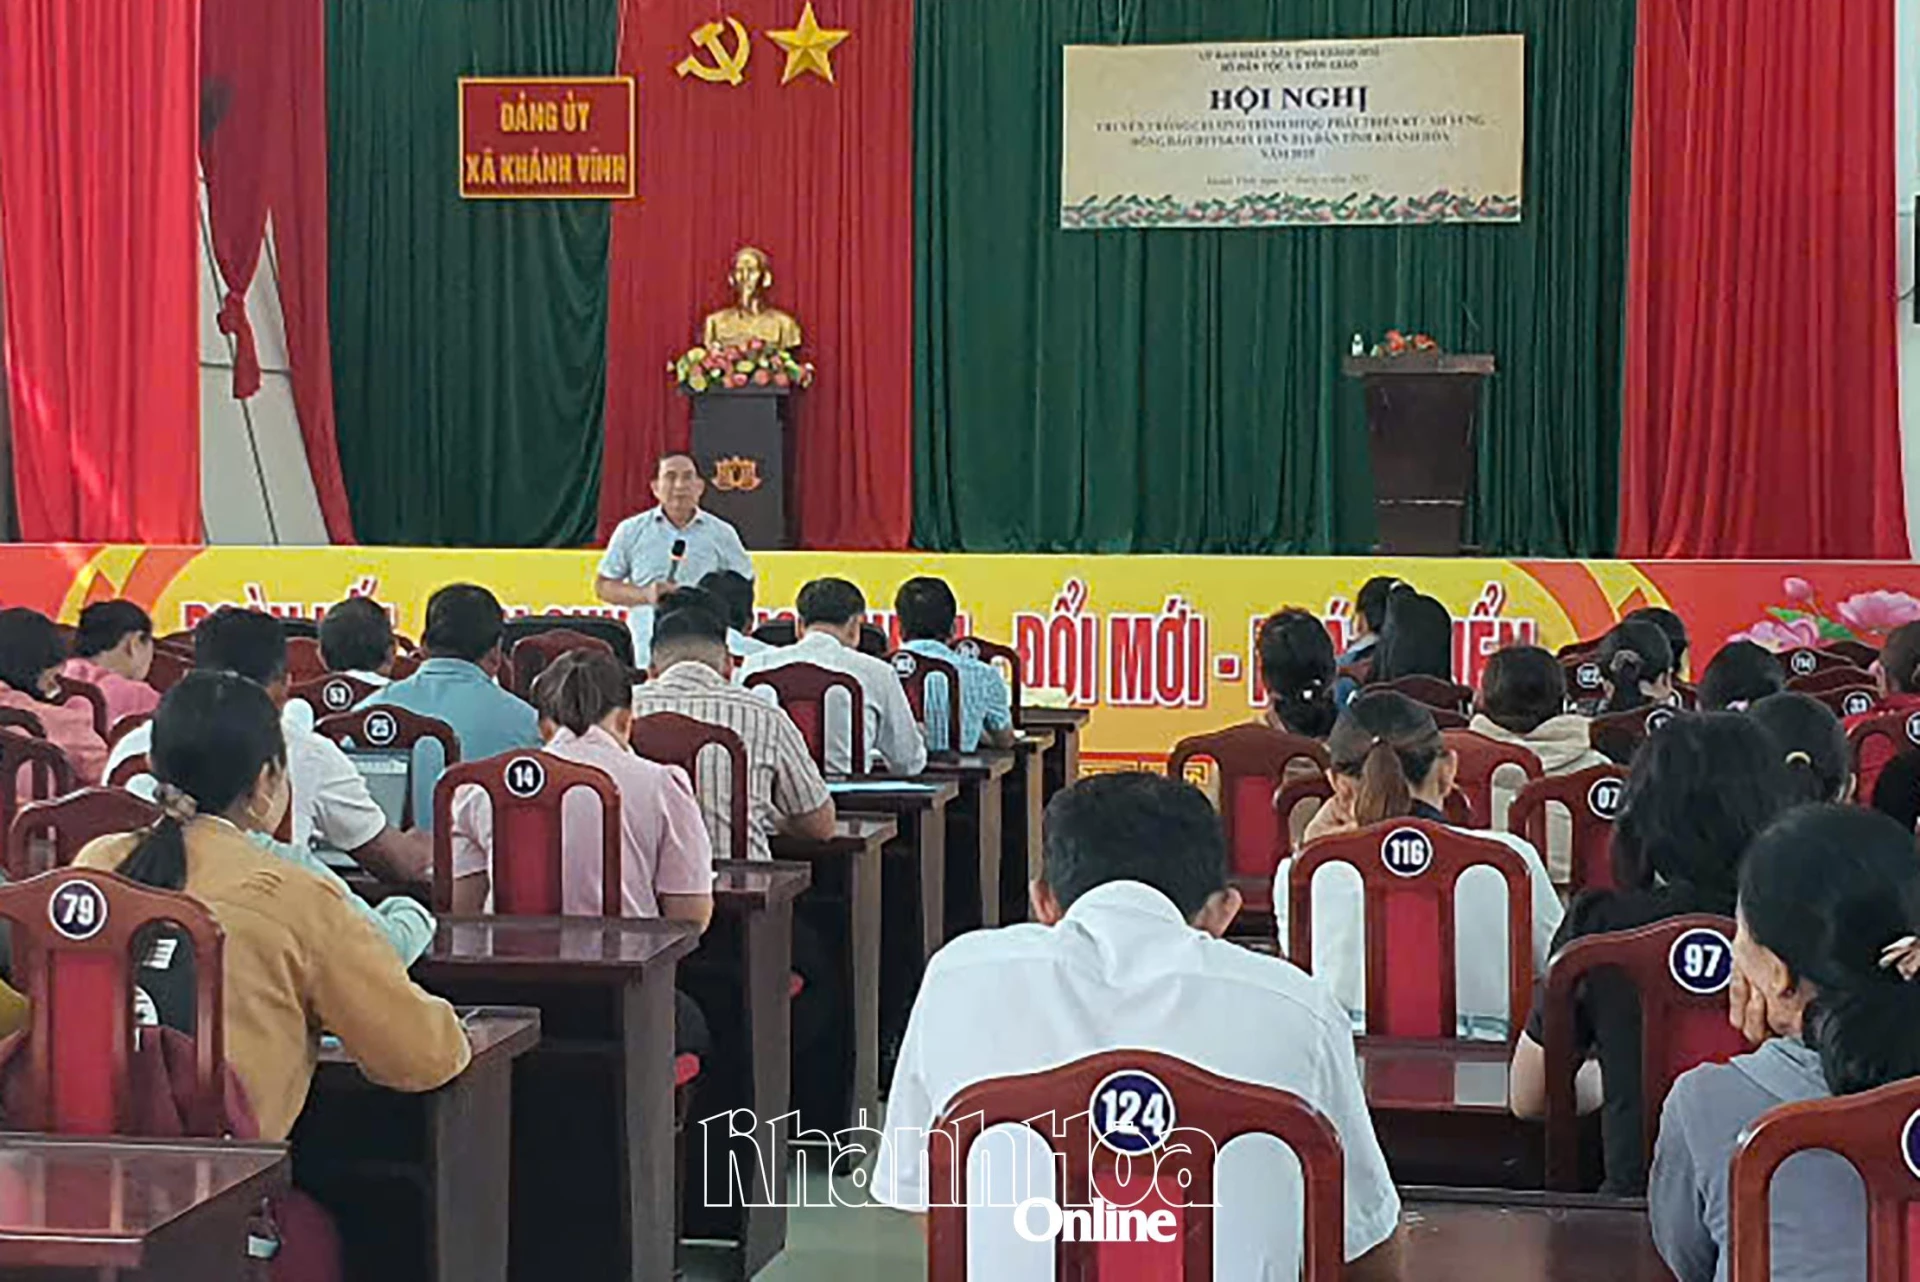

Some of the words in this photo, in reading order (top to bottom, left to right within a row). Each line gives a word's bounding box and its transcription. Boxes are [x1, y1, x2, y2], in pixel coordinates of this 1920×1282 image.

[501, 90, 559, 132] ĐẢNG
[563, 90, 590, 132] ỦY
[1209, 85, 1272, 116] HỘI
[1282, 85, 1369, 114] NGHỊ
[465, 146, 497, 184] XÃ
[500, 146, 572, 184] KHÁNH
[577, 146, 627, 184] VĨNH
[1014, 578, 1098, 704] ĐỔI
[1107, 596, 1206, 705] MỚI
[514, 766, 534, 788] 14
[1390, 839, 1425, 866] 116
[62, 893, 95, 926] 79
[1683, 943, 1723, 978] 97
[1101, 1089, 1165, 1137] 124
